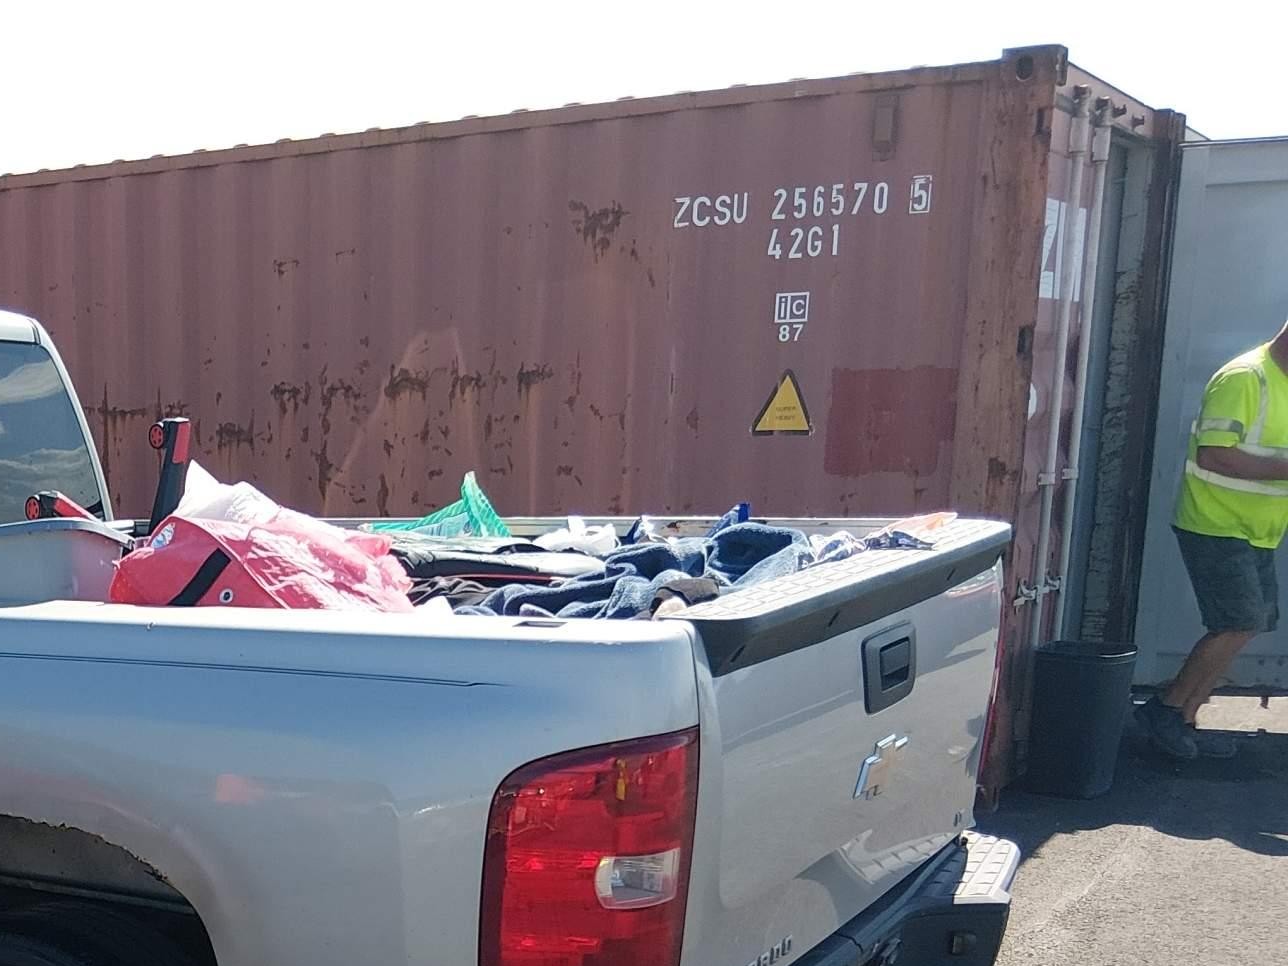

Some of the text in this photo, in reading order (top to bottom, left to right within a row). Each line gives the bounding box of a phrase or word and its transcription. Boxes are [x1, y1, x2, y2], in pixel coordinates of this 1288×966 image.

[673, 177, 930, 228] ZCSU 256570 5
[767, 223, 840, 259] 42G1
[778, 324, 803, 342] 87
